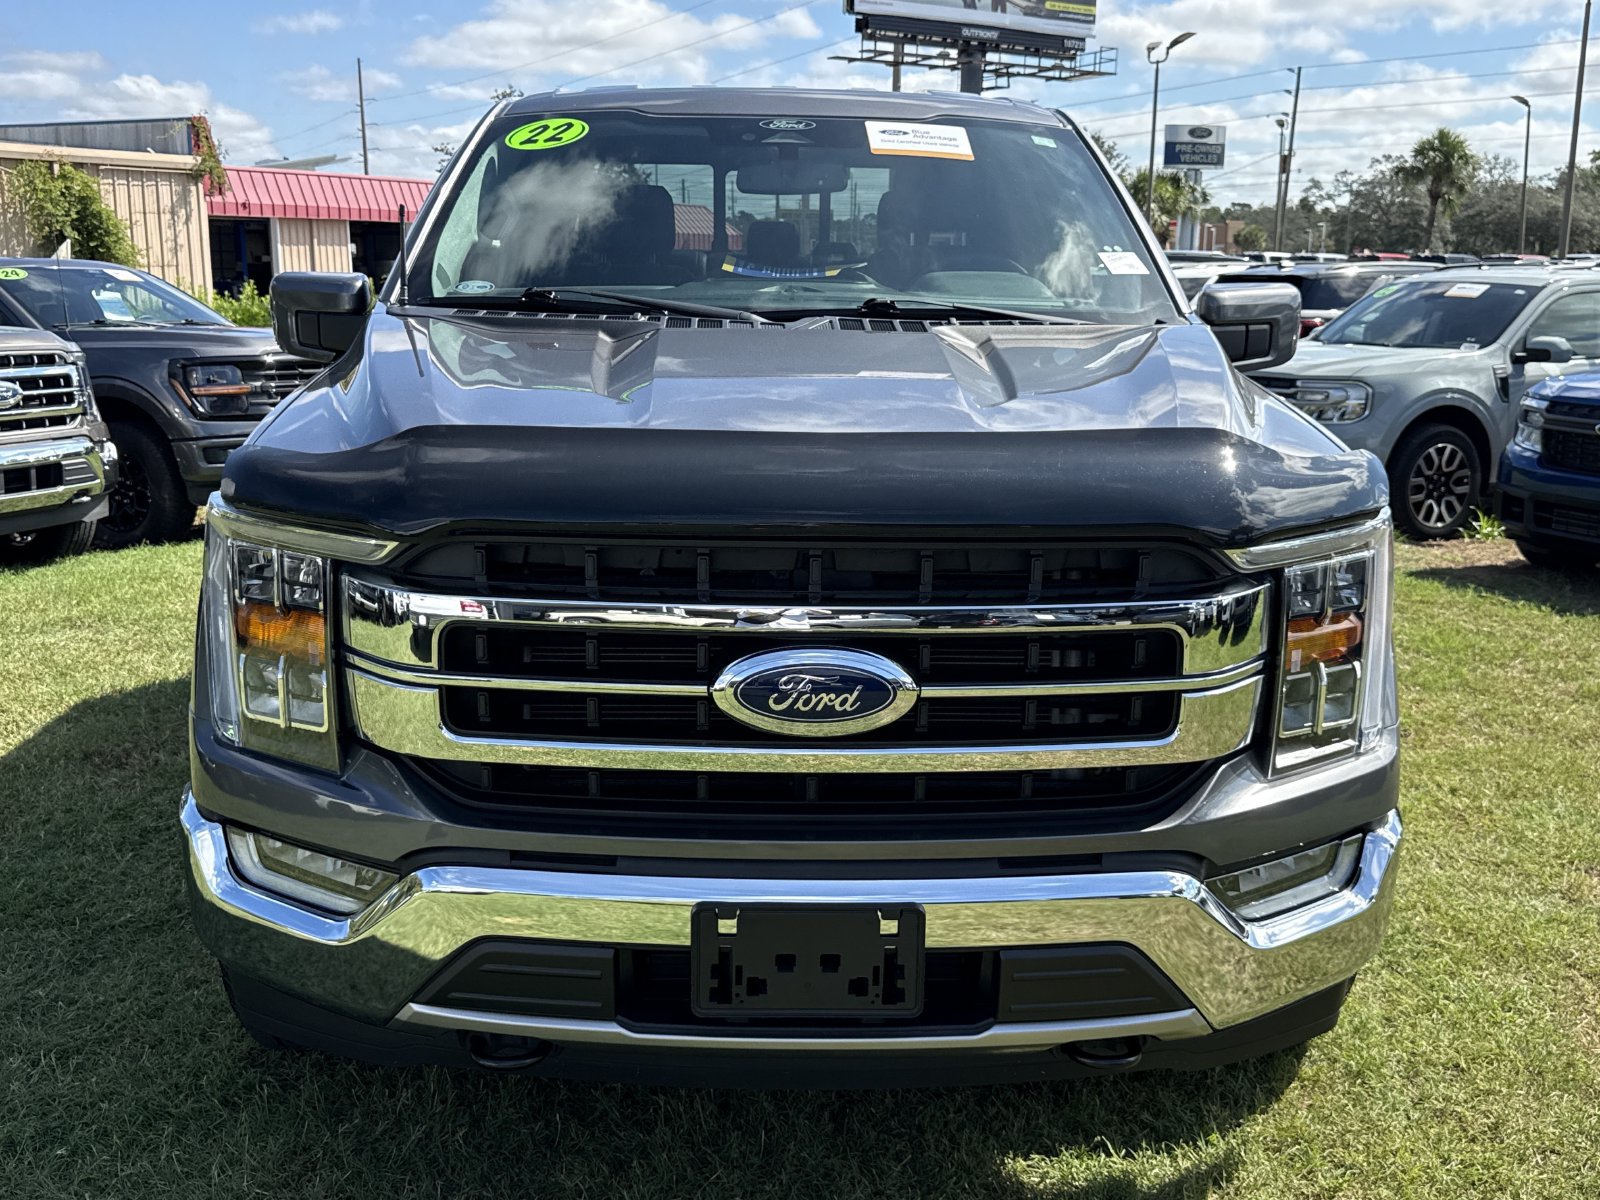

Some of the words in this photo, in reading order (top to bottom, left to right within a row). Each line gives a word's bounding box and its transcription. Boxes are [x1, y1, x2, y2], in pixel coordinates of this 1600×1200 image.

[769, 120, 806, 129] Ford
[519, 121, 575, 146] 22
[913, 134, 957, 143] Advantage
[1175, 144, 1222, 154] PRE-OWNED
[1179, 154, 1218, 163] VEHICLES
[768, 674, 864, 712] Ford
